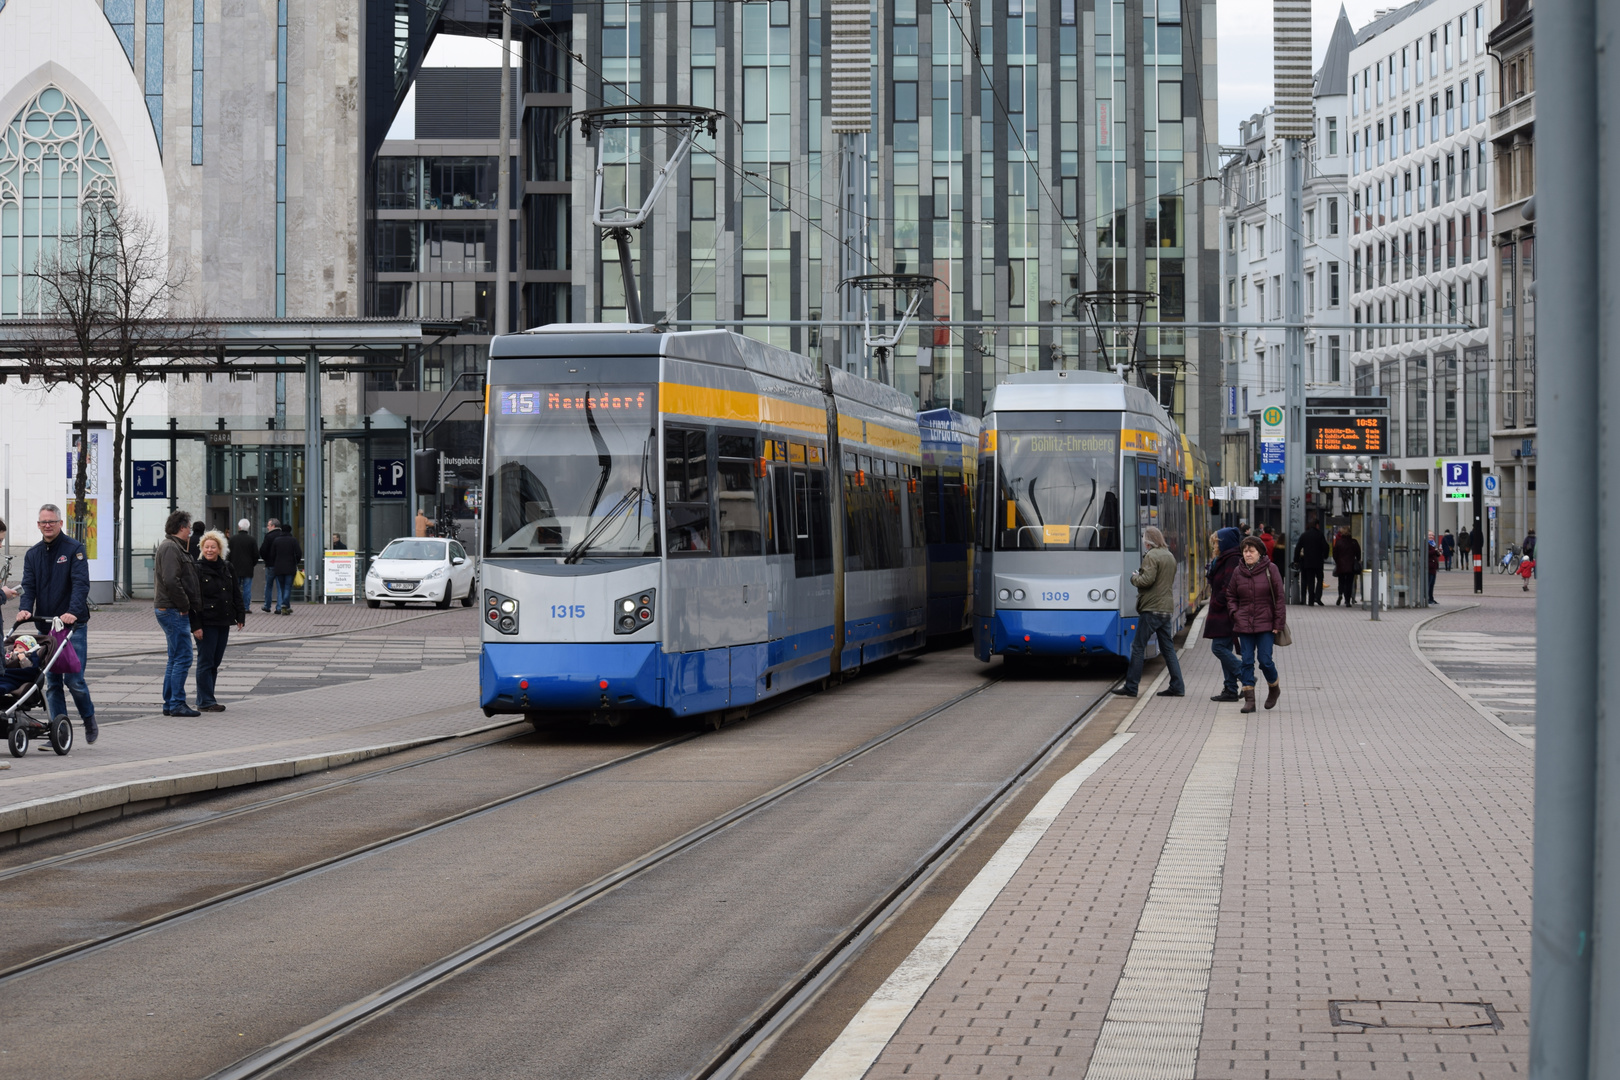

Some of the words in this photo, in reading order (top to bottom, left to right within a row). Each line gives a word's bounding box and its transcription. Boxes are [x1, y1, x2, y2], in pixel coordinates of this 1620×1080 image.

[1099, 103, 1109, 145] augenlaser
[507, 393, 535, 413] 15
[548, 391, 645, 410] Meusdorf
[1356, 418, 1378, 427] 10:52
[1011, 436, 1021, 454] 7
[1031, 435, 1114, 454] Böhlitz-Ehrenberg
[1041, 591, 1070, 602] 1309
[550, 604, 586, 619] 1315
